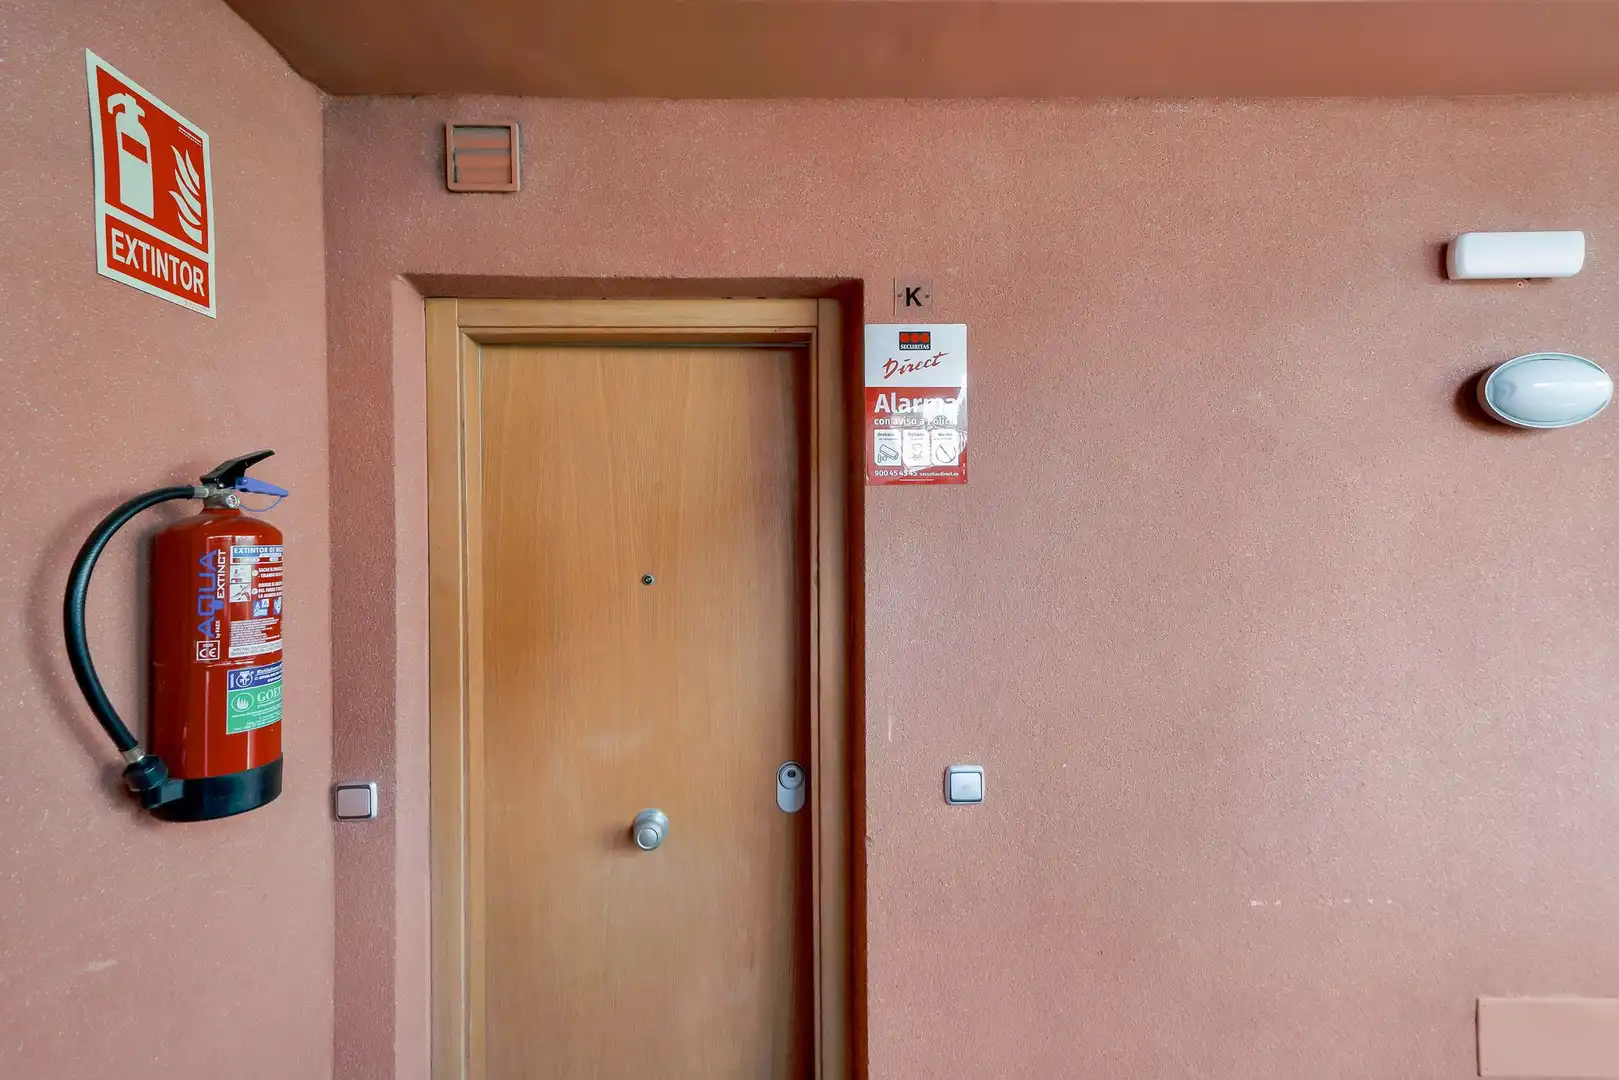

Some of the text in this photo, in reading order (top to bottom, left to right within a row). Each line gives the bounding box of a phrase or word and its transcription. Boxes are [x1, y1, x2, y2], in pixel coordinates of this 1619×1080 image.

[111, 227, 205, 297] EXTINTOR
[905, 287, 922, 307] K
[881, 351, 950, 380] Direct
[873, 418, 891, 426] con
[893, 417, 917, 426] aviso
[919, 418, 925, 426] a
[874, 469, 889, 477] 900
[233, 546, 269, 555] EXTINTOR
[216, 548, 227, 599] EXTINCT
[197, 549, 225, 638] AQUA
[199, 648, 217, 658] CE
